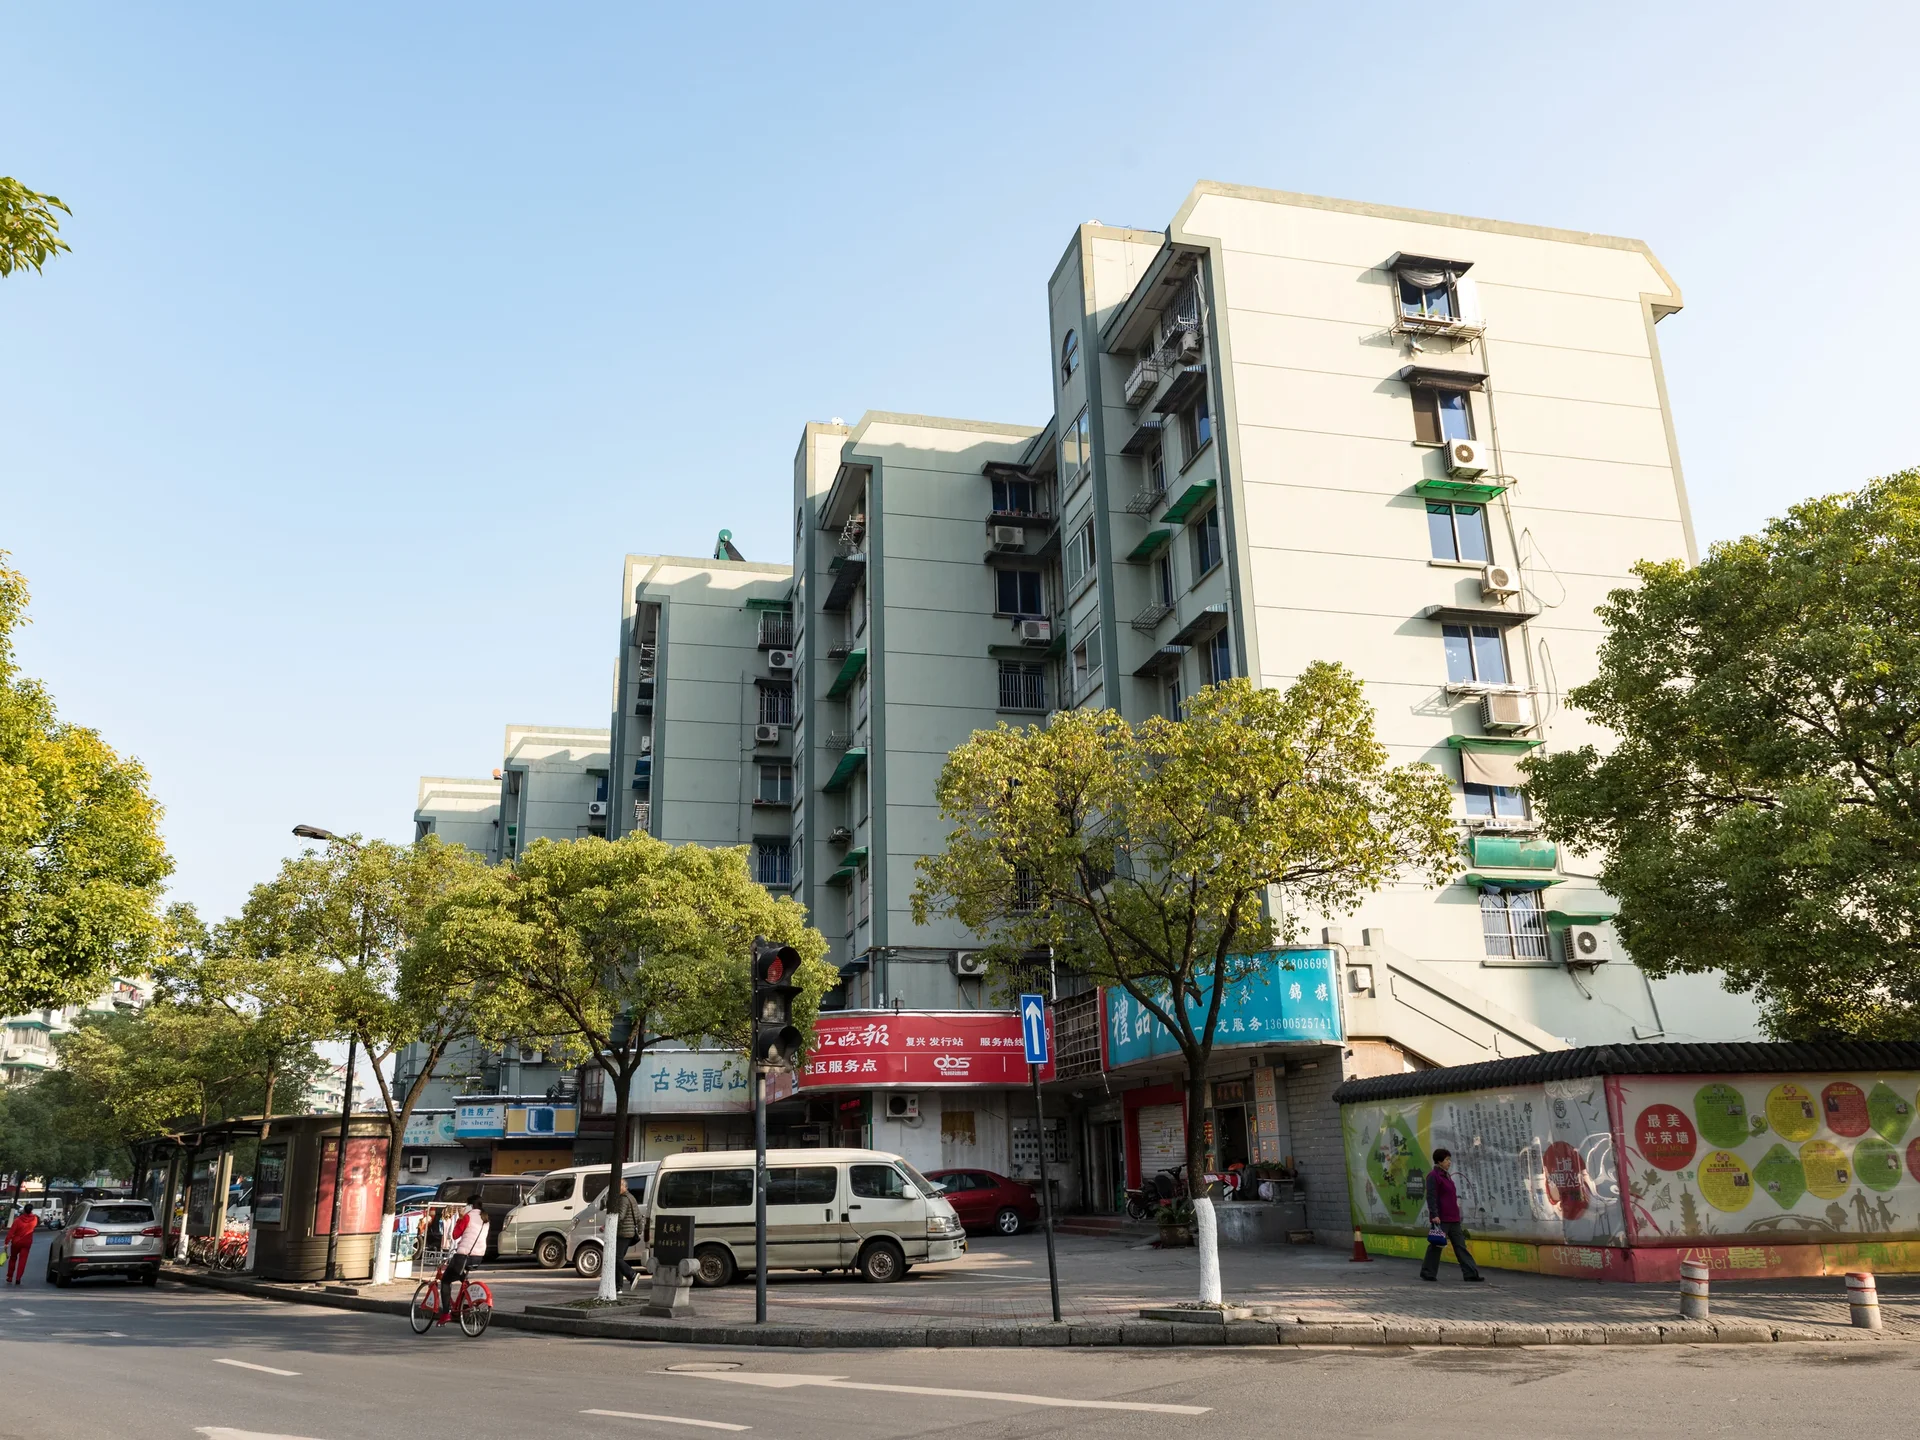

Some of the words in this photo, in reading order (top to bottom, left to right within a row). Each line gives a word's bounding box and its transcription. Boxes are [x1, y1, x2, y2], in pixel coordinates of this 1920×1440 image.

[1193, 1016, 1262, 1034] 一龙服务
[1265, 1017, 1331, 1031] 13600525741
[809, 1023, 889, 1053] 江晚报
[905, 1036, 926, 1047] 复兴
[929, 1036, 964, 1047] 发行站
[979, 1036, 1025, 1047] 服务热线
[804, 1058, 878, 1076] 社区服务点
[471, 1118, 494, 1127] sheng
[1647, 1113, 1681, 1128] 最美
[1644, 1131, 1689, 1145] 光荣墙
[1727, 1247, 1767, 1269] 最美
